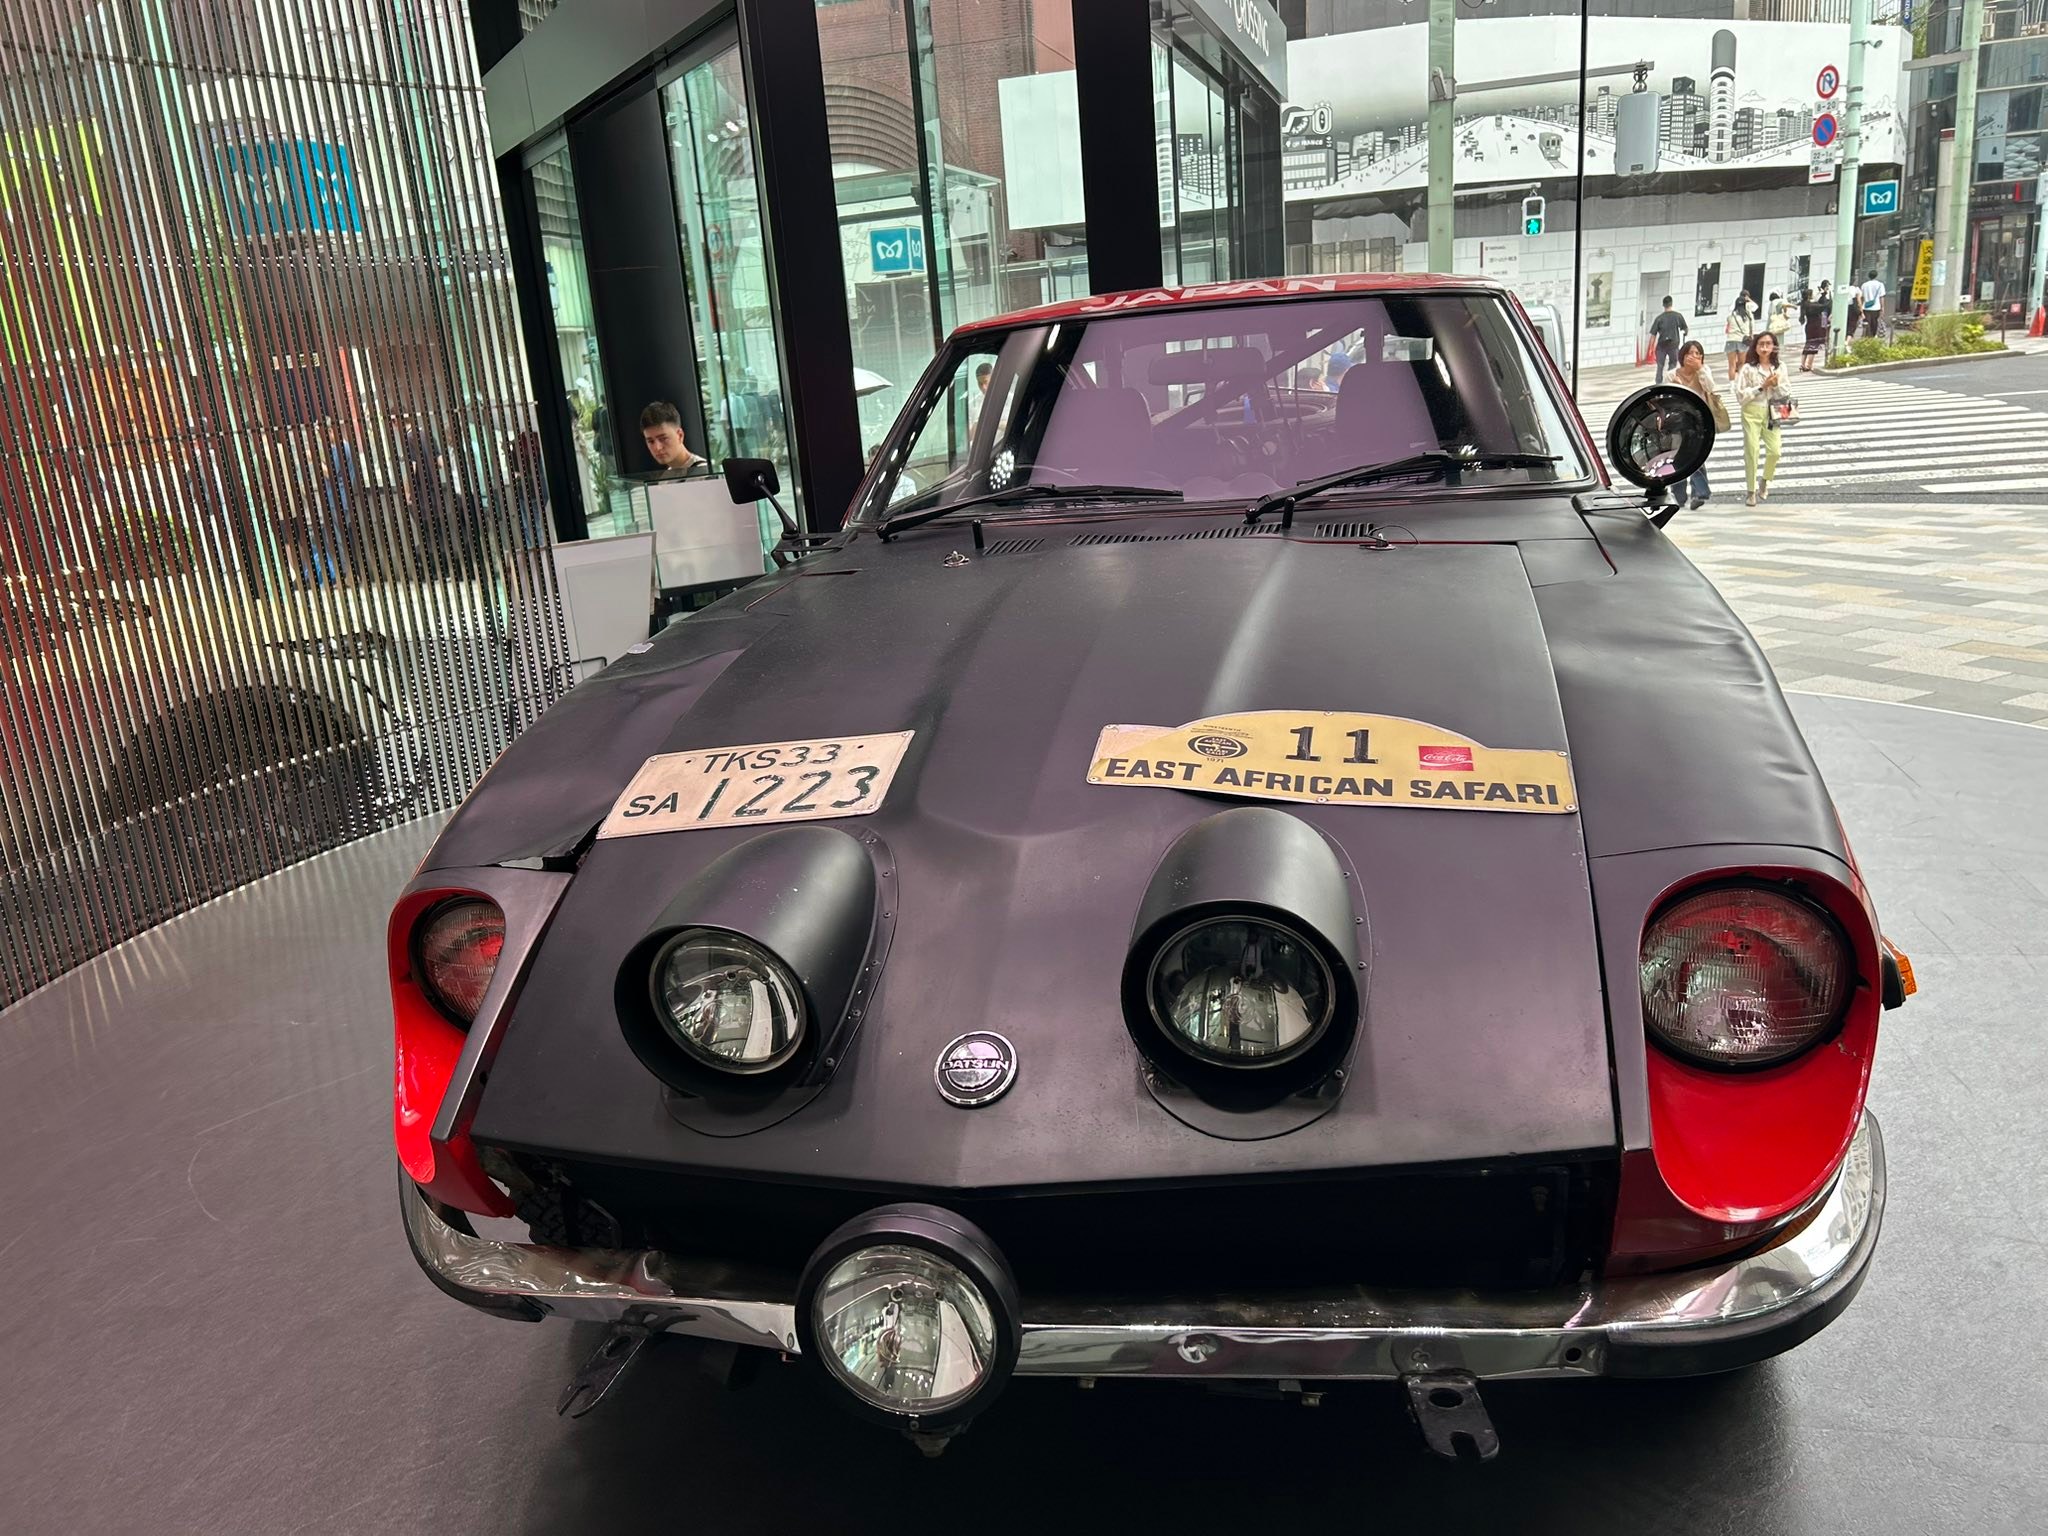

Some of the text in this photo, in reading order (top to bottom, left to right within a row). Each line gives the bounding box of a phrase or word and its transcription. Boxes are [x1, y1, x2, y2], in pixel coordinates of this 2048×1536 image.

[1080, 279, 1336, 312] JAPAN
[1286, 726, 1379, 765] 11
[623, 765, 881, 821] SA 1223
[1106, 758, 1559, 805] EAST AFRICAN SAFARI
[942, 1060, 1009, 1070] DATSUN
